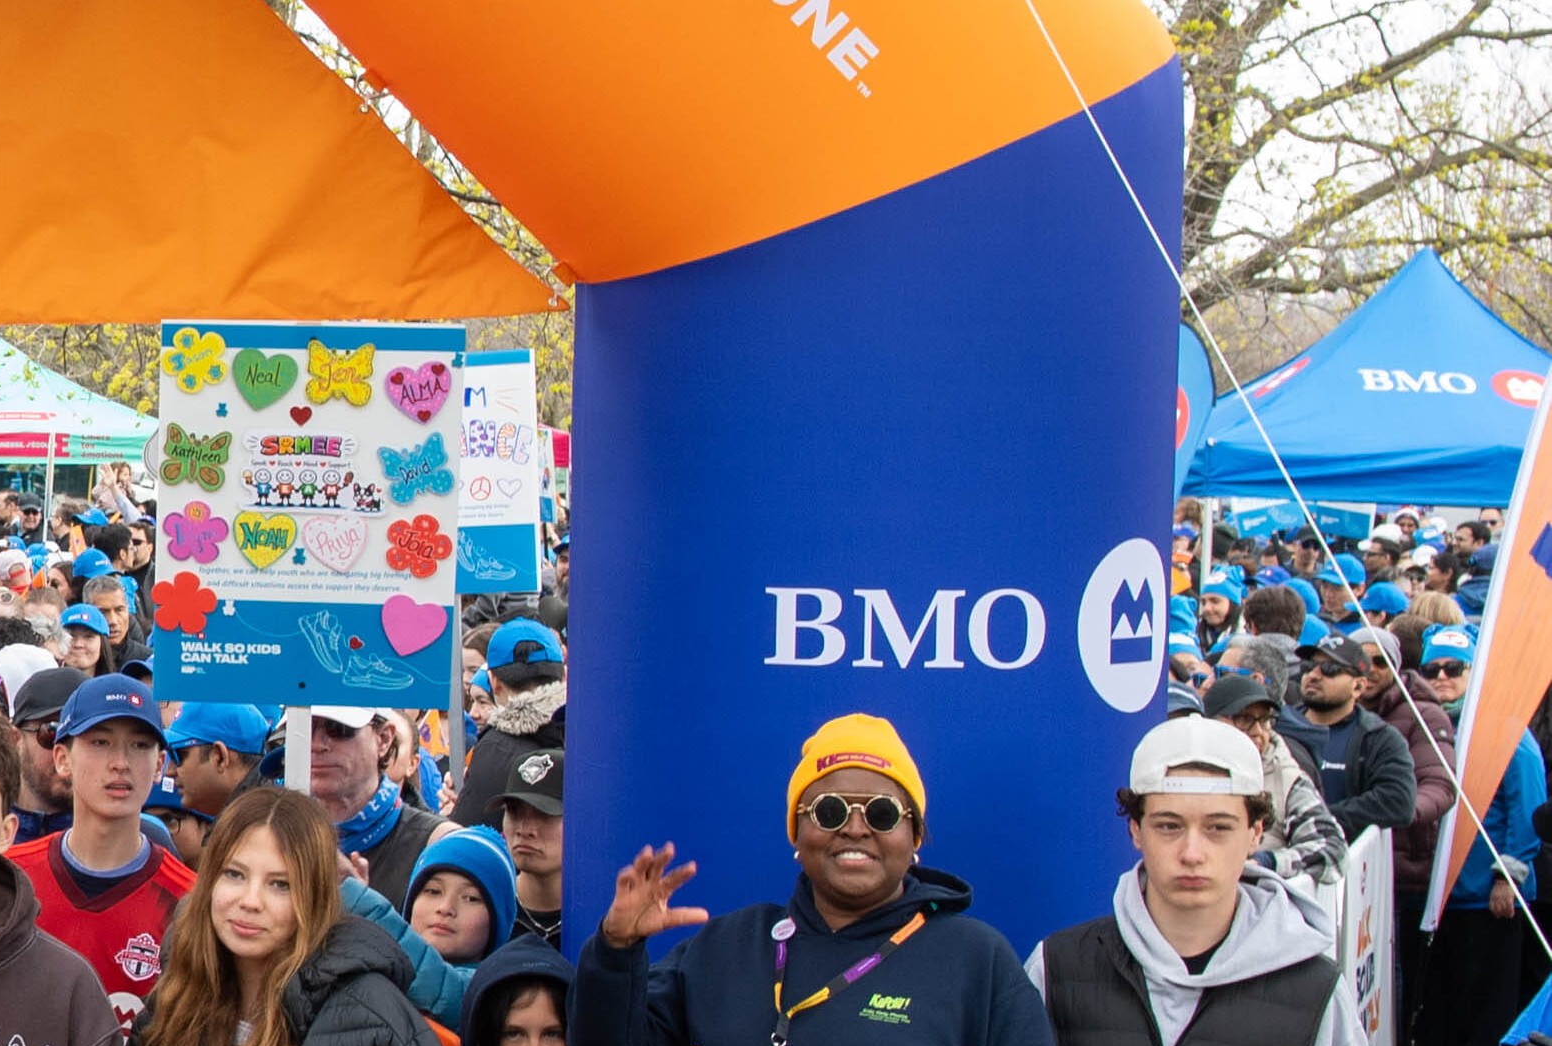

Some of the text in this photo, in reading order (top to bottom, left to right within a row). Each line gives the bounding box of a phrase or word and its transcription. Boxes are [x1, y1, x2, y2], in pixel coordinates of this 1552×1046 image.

[246, 361, 282, 387] Neal
[1357, 367, 1478, 395] BMO
[399, 377, 448, 406] ALMA
[260, 435, 342, 458] SRMEE
[398, 458, 433, 483] David
[764, 586, 1047, 669] BMO
[181, 641, 282, 656] WALK SO KIDS
[181, 652, 249, 665] CAN TALK
